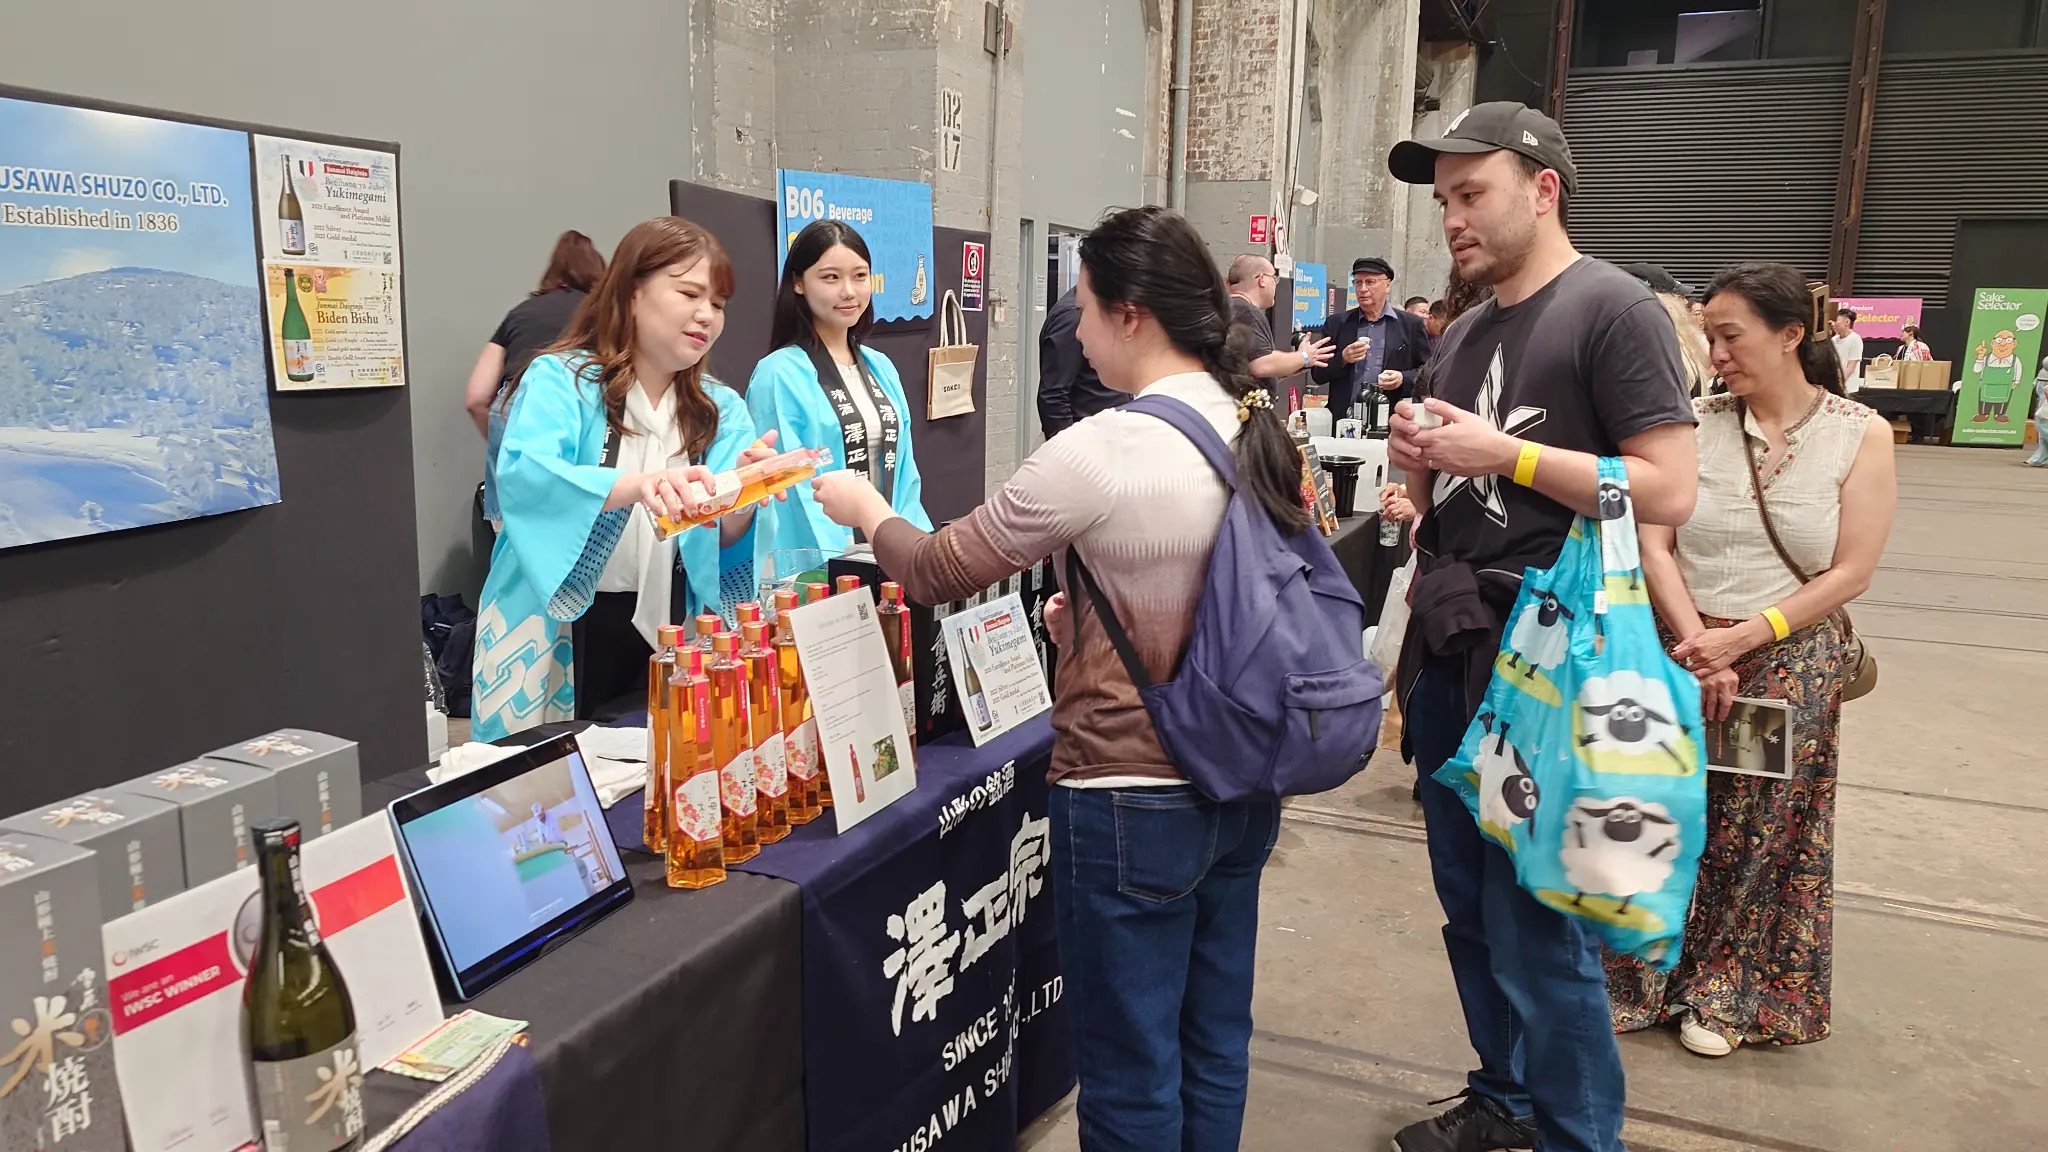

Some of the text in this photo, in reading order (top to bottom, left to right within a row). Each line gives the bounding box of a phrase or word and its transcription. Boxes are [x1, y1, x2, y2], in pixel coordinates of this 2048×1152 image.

[81, 174, 147, 199] SHUZO
[152, 181, 188, 205] CO.,
[191, 184, 228, 206] LTD.
[325, 186, 386, 205] Yukimegami
[786, 185, 873, 224] B06 Beverage
[4, 204, 178, 232] Established in 1836
[325, 225, 342, 233] Silver
[326, 233, 341, 241] Gold
[1977, 301, 2023, 311] Selector
[1980, 291, 2006, 302] Sake
[317, 311, 379, 324] Biden Bishu
[1855, 313, 1900, 323] Selector
[883, 811, 1051, 1037] 澤正宗
[124, 965, 221, 1017] IWSC WINNER
[942, 1007, 998, 1071] SINCE
[893, 1085, 977, 1152] USAWA
